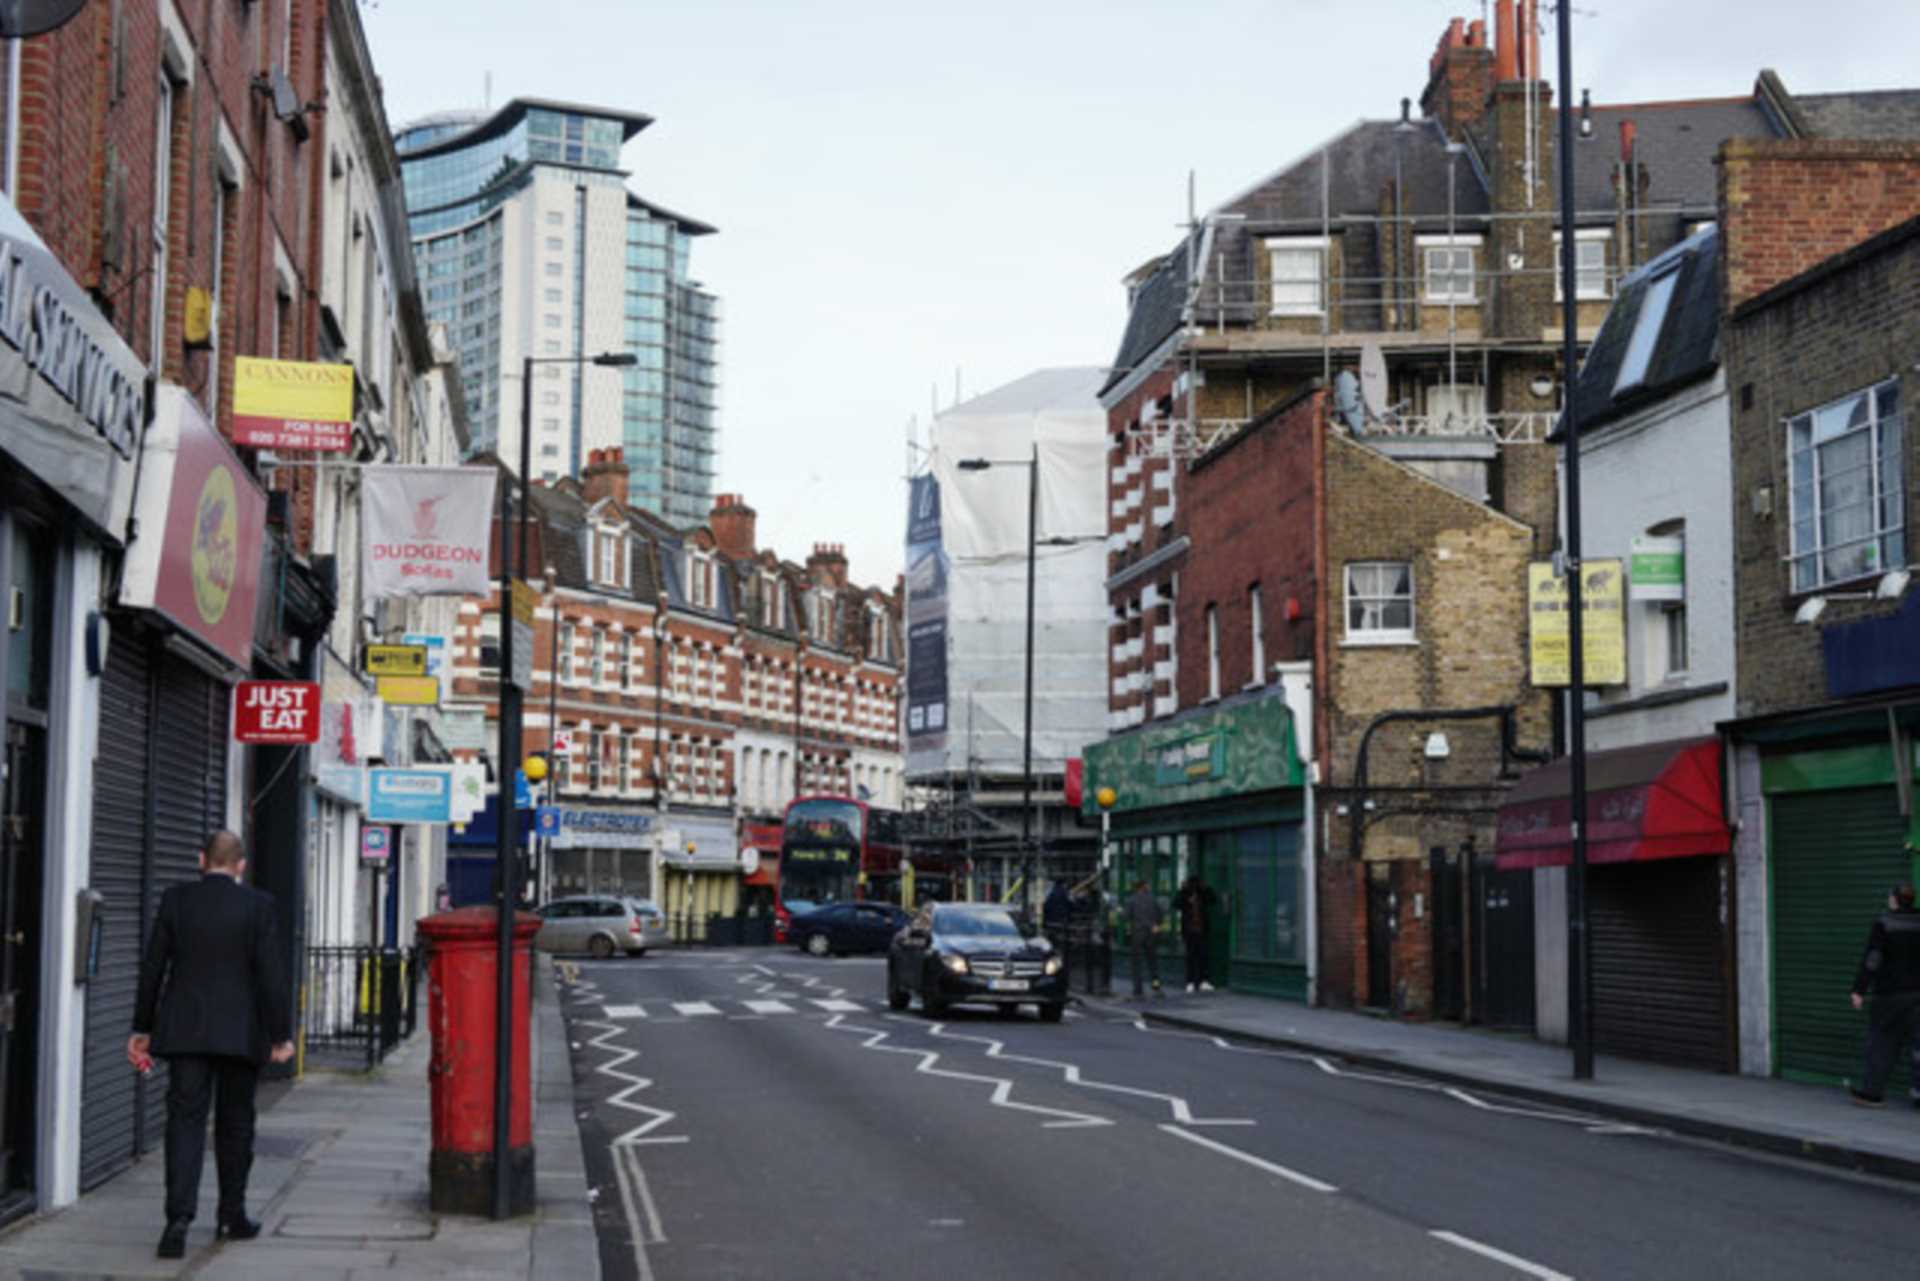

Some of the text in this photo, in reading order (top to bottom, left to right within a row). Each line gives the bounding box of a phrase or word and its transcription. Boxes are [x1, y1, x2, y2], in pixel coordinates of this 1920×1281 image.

[284, 421, 346, 434] FOR SALE
[372, 543, 482, 564] DUDGEON
[244, 686, 309, 708] JUST
[259, 708, 309, 730] EAT
